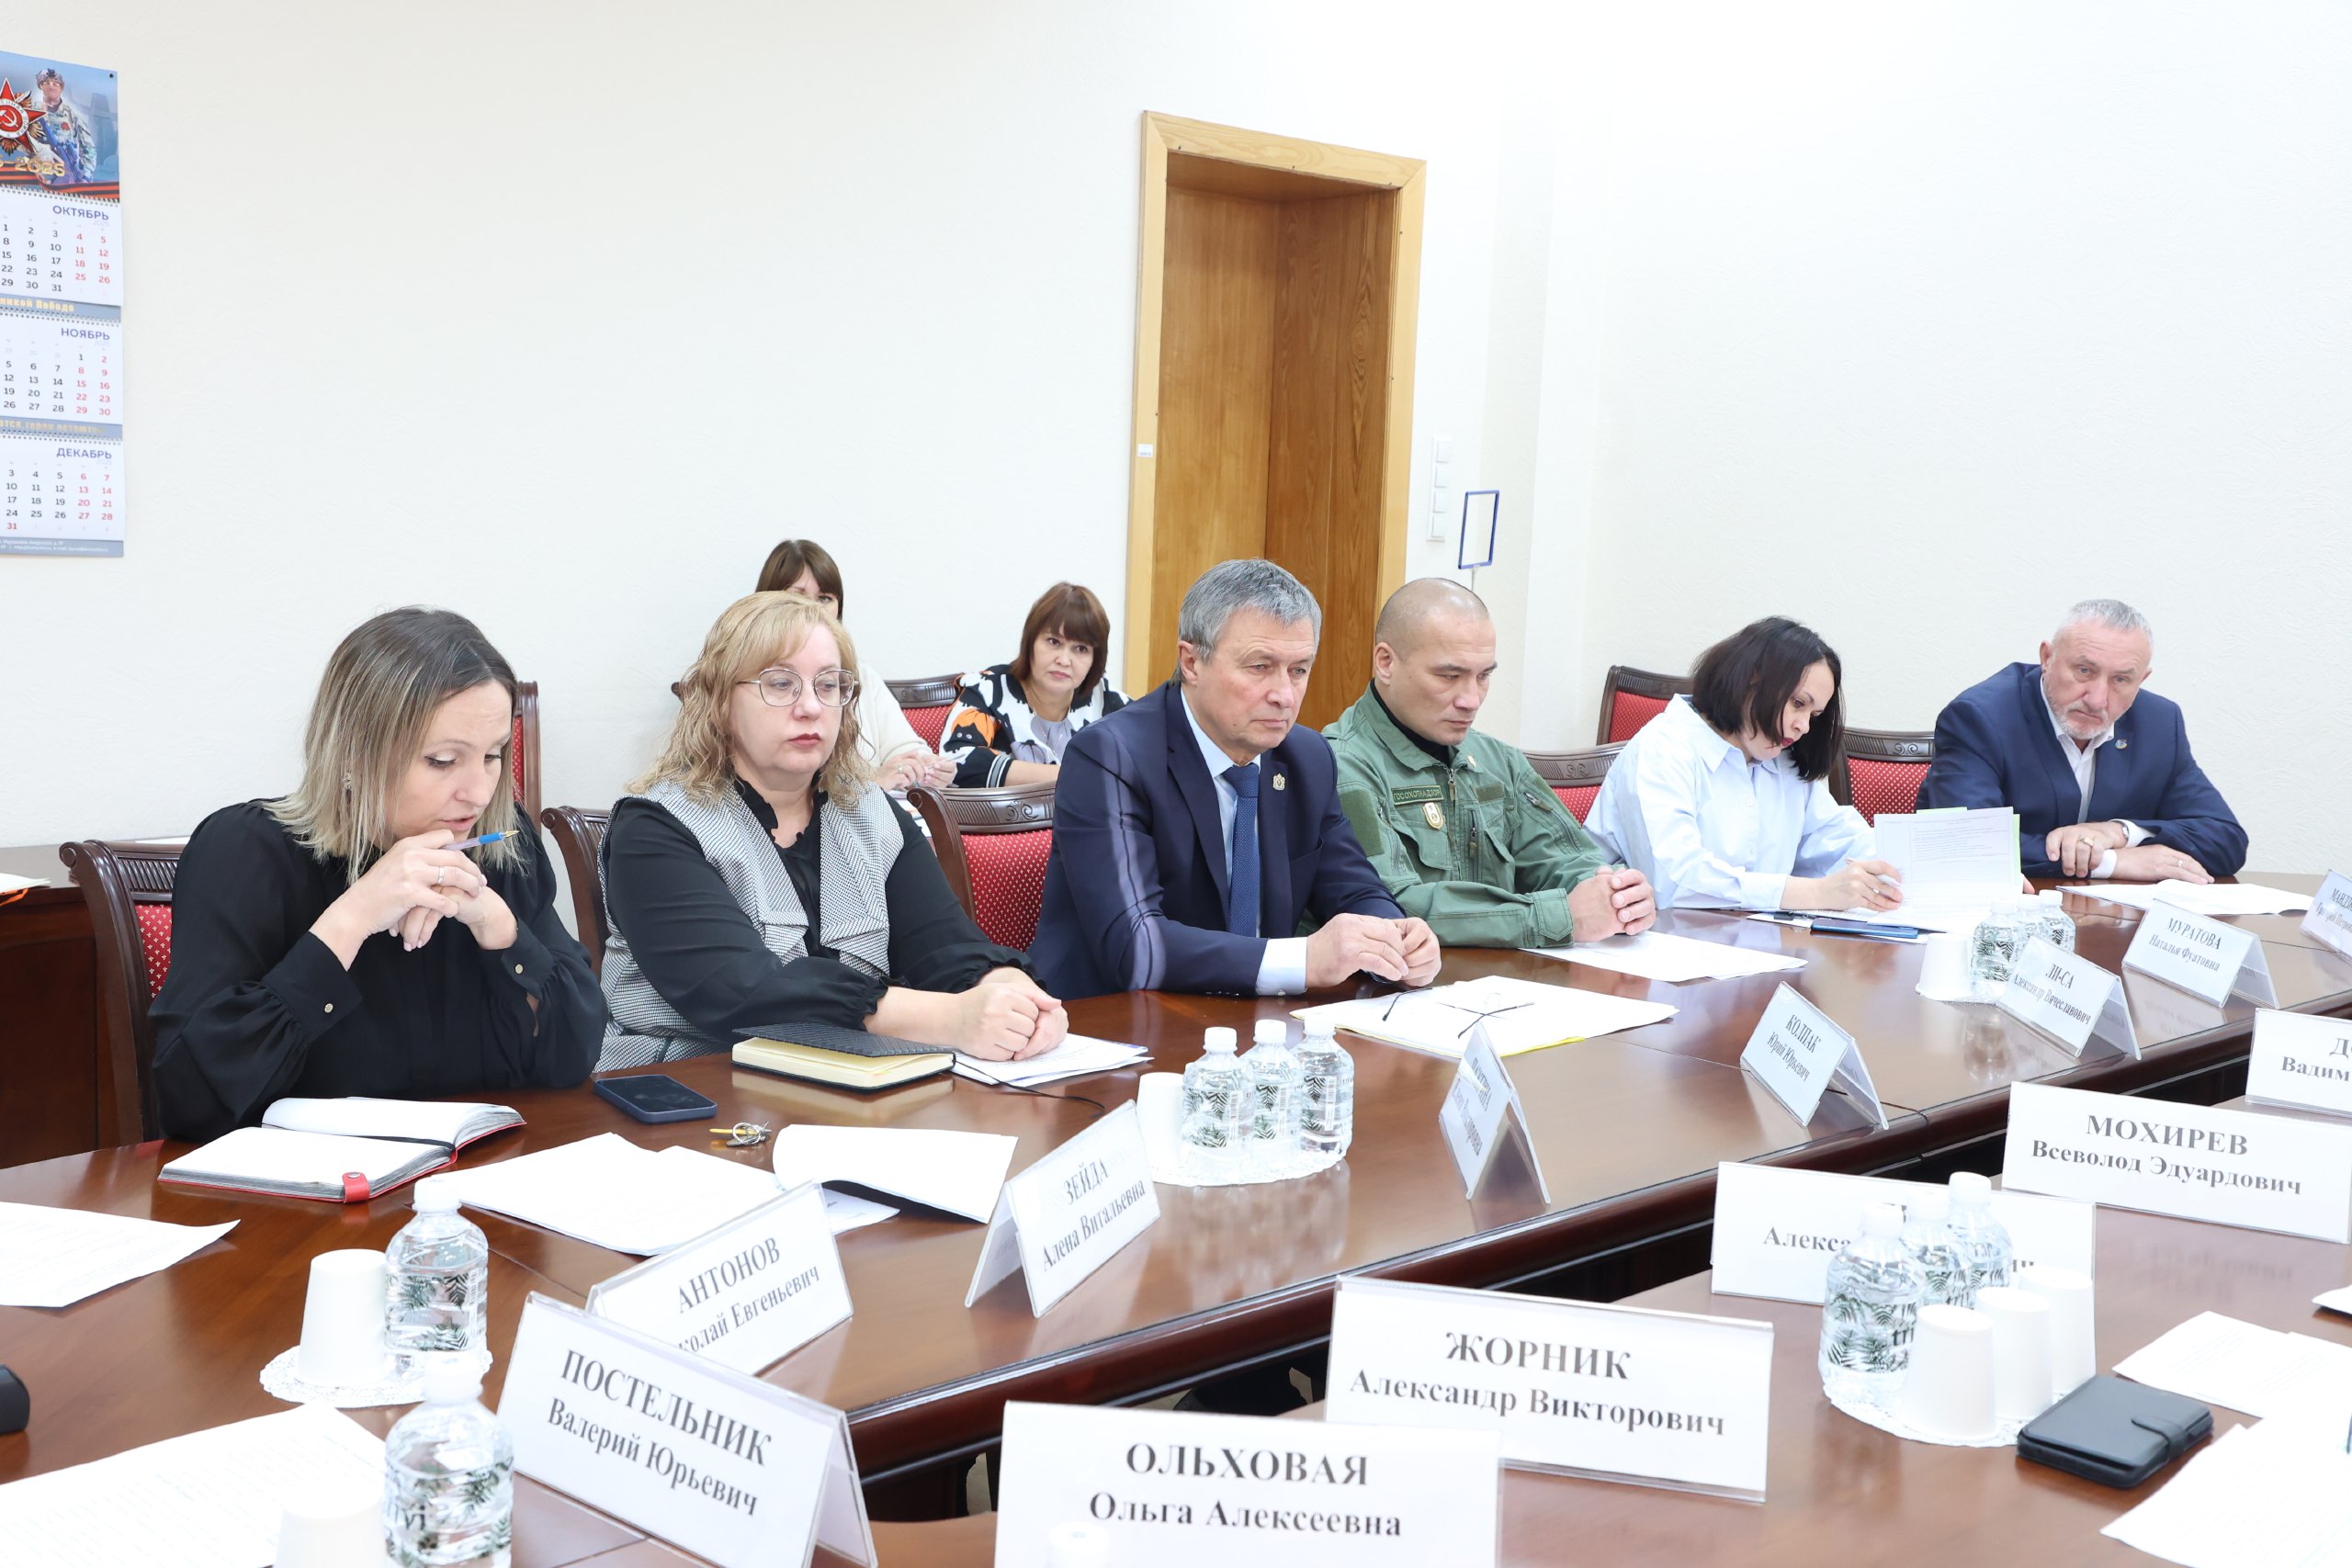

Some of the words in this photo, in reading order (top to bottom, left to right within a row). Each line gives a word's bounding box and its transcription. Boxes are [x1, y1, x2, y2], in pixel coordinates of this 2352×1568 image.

[52, 205, 109, 220] ОКТЯБРЬ
[2, 265, 13, 273] 22
[27, 281, 38, 289] 30
[61, 328, 110, 341] НОЯБРЬ
[56, 447, 112, 459] ДЕКАБРЬ
[1393, 789, 1442, 800] ГОСОХОТНАДЗОР
[2148, 933, 2183, 956] Наталья
[2181, 945, 2221, 972] Фуатовна
[2165, 917, 2222, 951] МУРАТОВА
[2044, 963, 2075, 989] ЛИ-СА
[2011, 972, 2045, 1005] Александр
[2044, 987, 2091, 1026] Вячеславович
[1785, 1014, 1821, 1054] КОЛПАК
[1767, 1031, 1787, 1058] Юрий
[1782, 1048, 1811, 1082] Юрьевич
[2281, 1055, 2350, 1082] Вадим
[2086, 1114, 2248, 1156] МОХИРЕВ
[1063, 1157, 1109, 1206] ЗЕЙДА
[2031, 1139, 2142, 1173] Всеволод
[2150, 1156, 2301, 1195] Эдуардович
[1043, 1233, 1080, 1272] Алена
[1080, 1179, 1146, 1241] Витальевна
[1763, 1226, 1851, 1252] Алекса
[679, 1237, 780, 1314] АНТОНОВ
[678, 1312, 729, 1353] колай
[730, 1266, 820, 1328] Евгеньевич
[1445, 1332, 1632, 1381] ЖОРНИК
[560, 1349, 773, 1467] ПОСТЕЛЬНИК
[1350, 1369, 1517, 1416] Александр
[1530, 1388, 1725, 1436] Викторович
[548, 1396, 642, 1463] Валерий
[645, 1440, 759, 1517] Юрьевич
[1126, 1442, 1369, 1486] ОЛЬХОВАЯ
[1090, 1492, 1193, 1525] Ольга
[1205, 1499, 1402, 1537] Алексеевна
